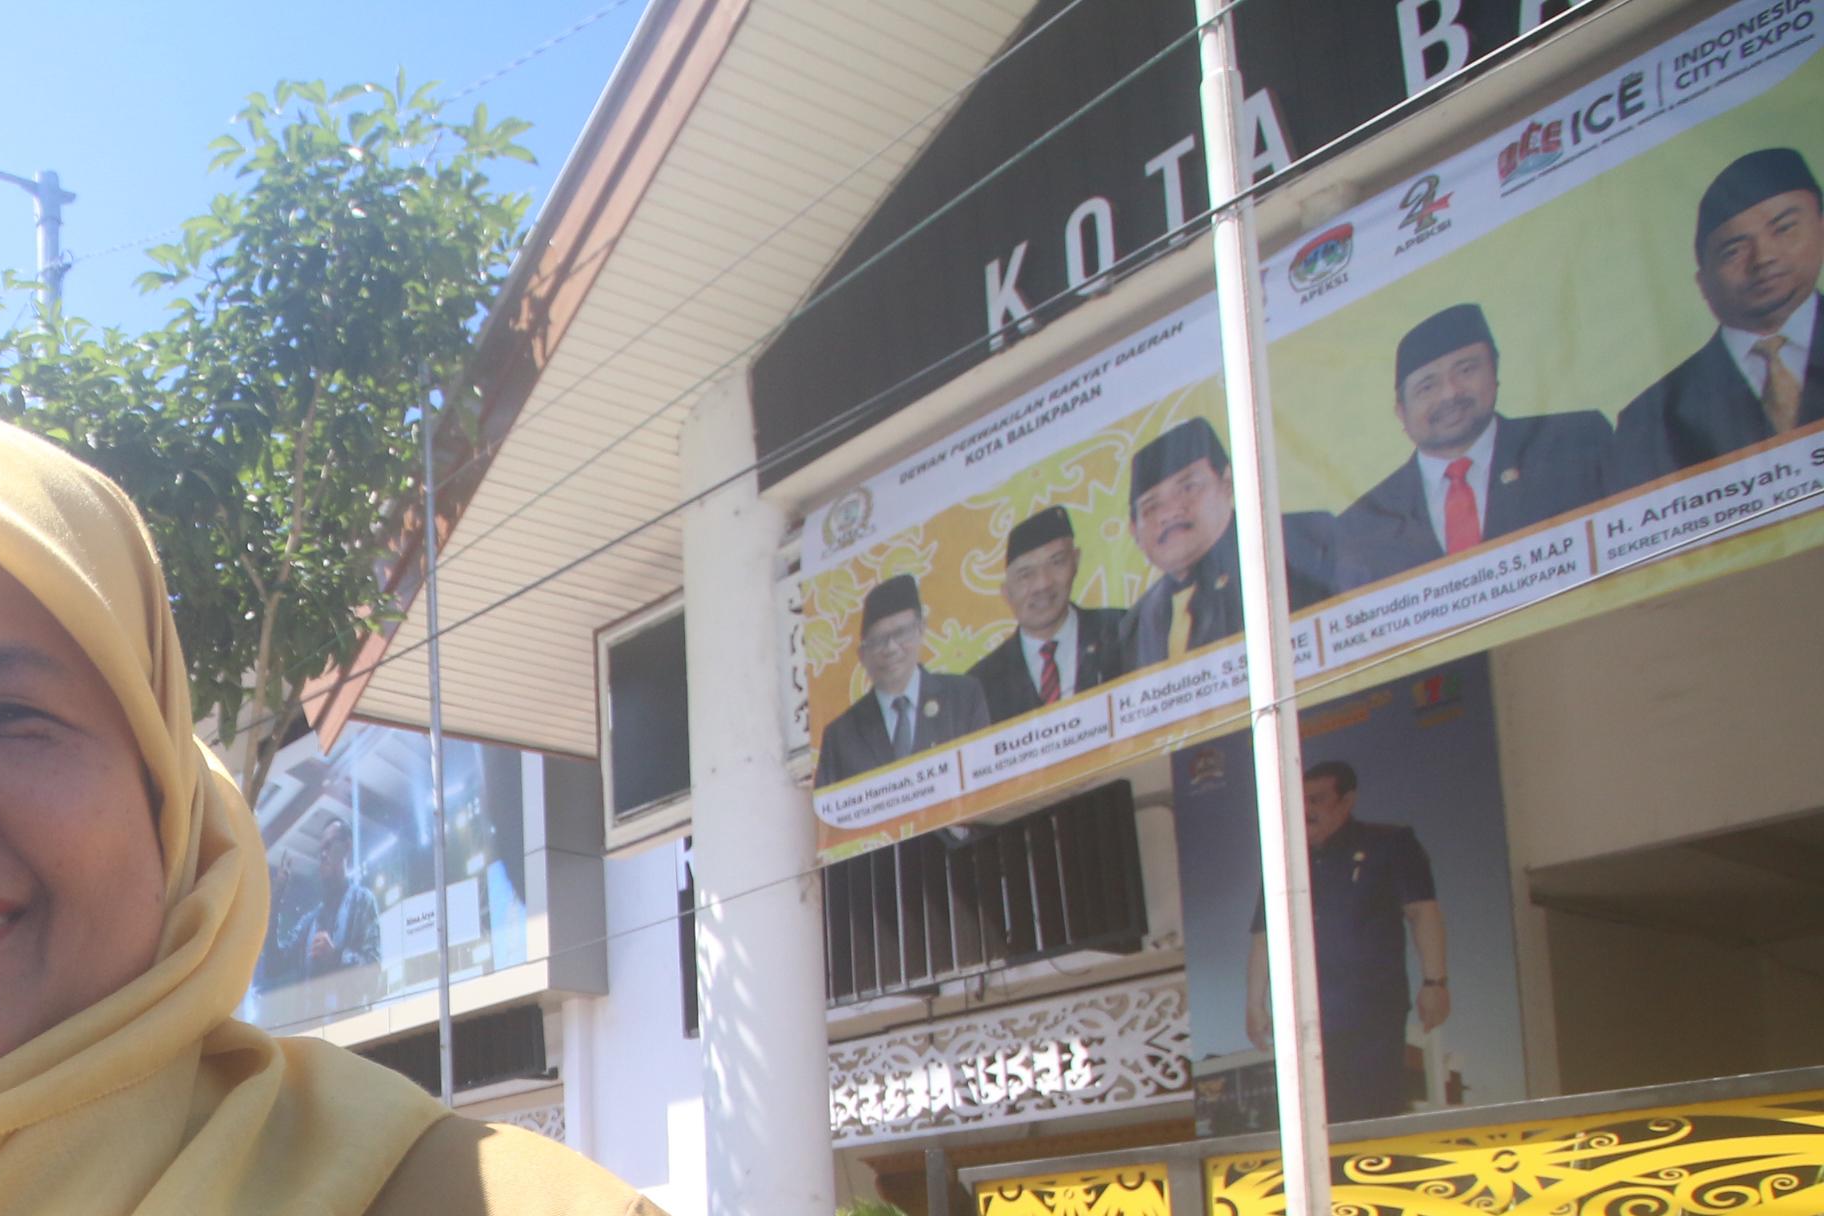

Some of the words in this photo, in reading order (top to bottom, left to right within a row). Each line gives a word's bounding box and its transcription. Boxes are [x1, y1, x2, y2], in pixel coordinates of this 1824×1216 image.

[1674, 0, 1810, 72] INDONESIA
[1675, 50, 1732, 91] CITY
[1740, 10, 1815, 60] EXPO
[1571, 76, 1646, 146] ICE
[984, 86, 1298, 354] KOTA
[1395, 219, 1452, 256] APEKSI
[1300, 273, 1349, 304] APEKSI
[899, 453, 947, 484] DEWAN
[950, 397, 1045, 456] PERWAKILAN
[1048, 360, 1112, 403] RAKYAT
[1114, 322, 1185, 367] DAERAH
[964, 439, 1002, 466] KOTA
[1007, 384, 1102, 443] BALIKPAPAN
[1607, 519, 1633, 539] H.
[1640, 463, 1802, 527] Arfiansyah,
[1607, 516, 1709, 560] SEKRETARIS
[1714, 499, 1764, 525] DPRD
[1773, 479, 1824, 505] KOTA
[1329, 621, 1343, 634] H.
[1345, 594, 1420, 626] Sabaruddin
[1530, 537, 1574, 565] M.A.P
[1333, 633, 1368, 652] WAKIL
[1370, 617, 1411, 639] KETUA
[1413, 604, 1449, 625] DPRD
[1452, 592, 1488, 612] KOTA
[1490, 561, 1577, 600] BALIKPAPAN
[994, 717, 1082, 756] Budiono
[1119, 704, 1159, 726] KETUA
[1161, 692, 1193, 712] DPRD
[1195, 681, 1228, 701] KOTA
